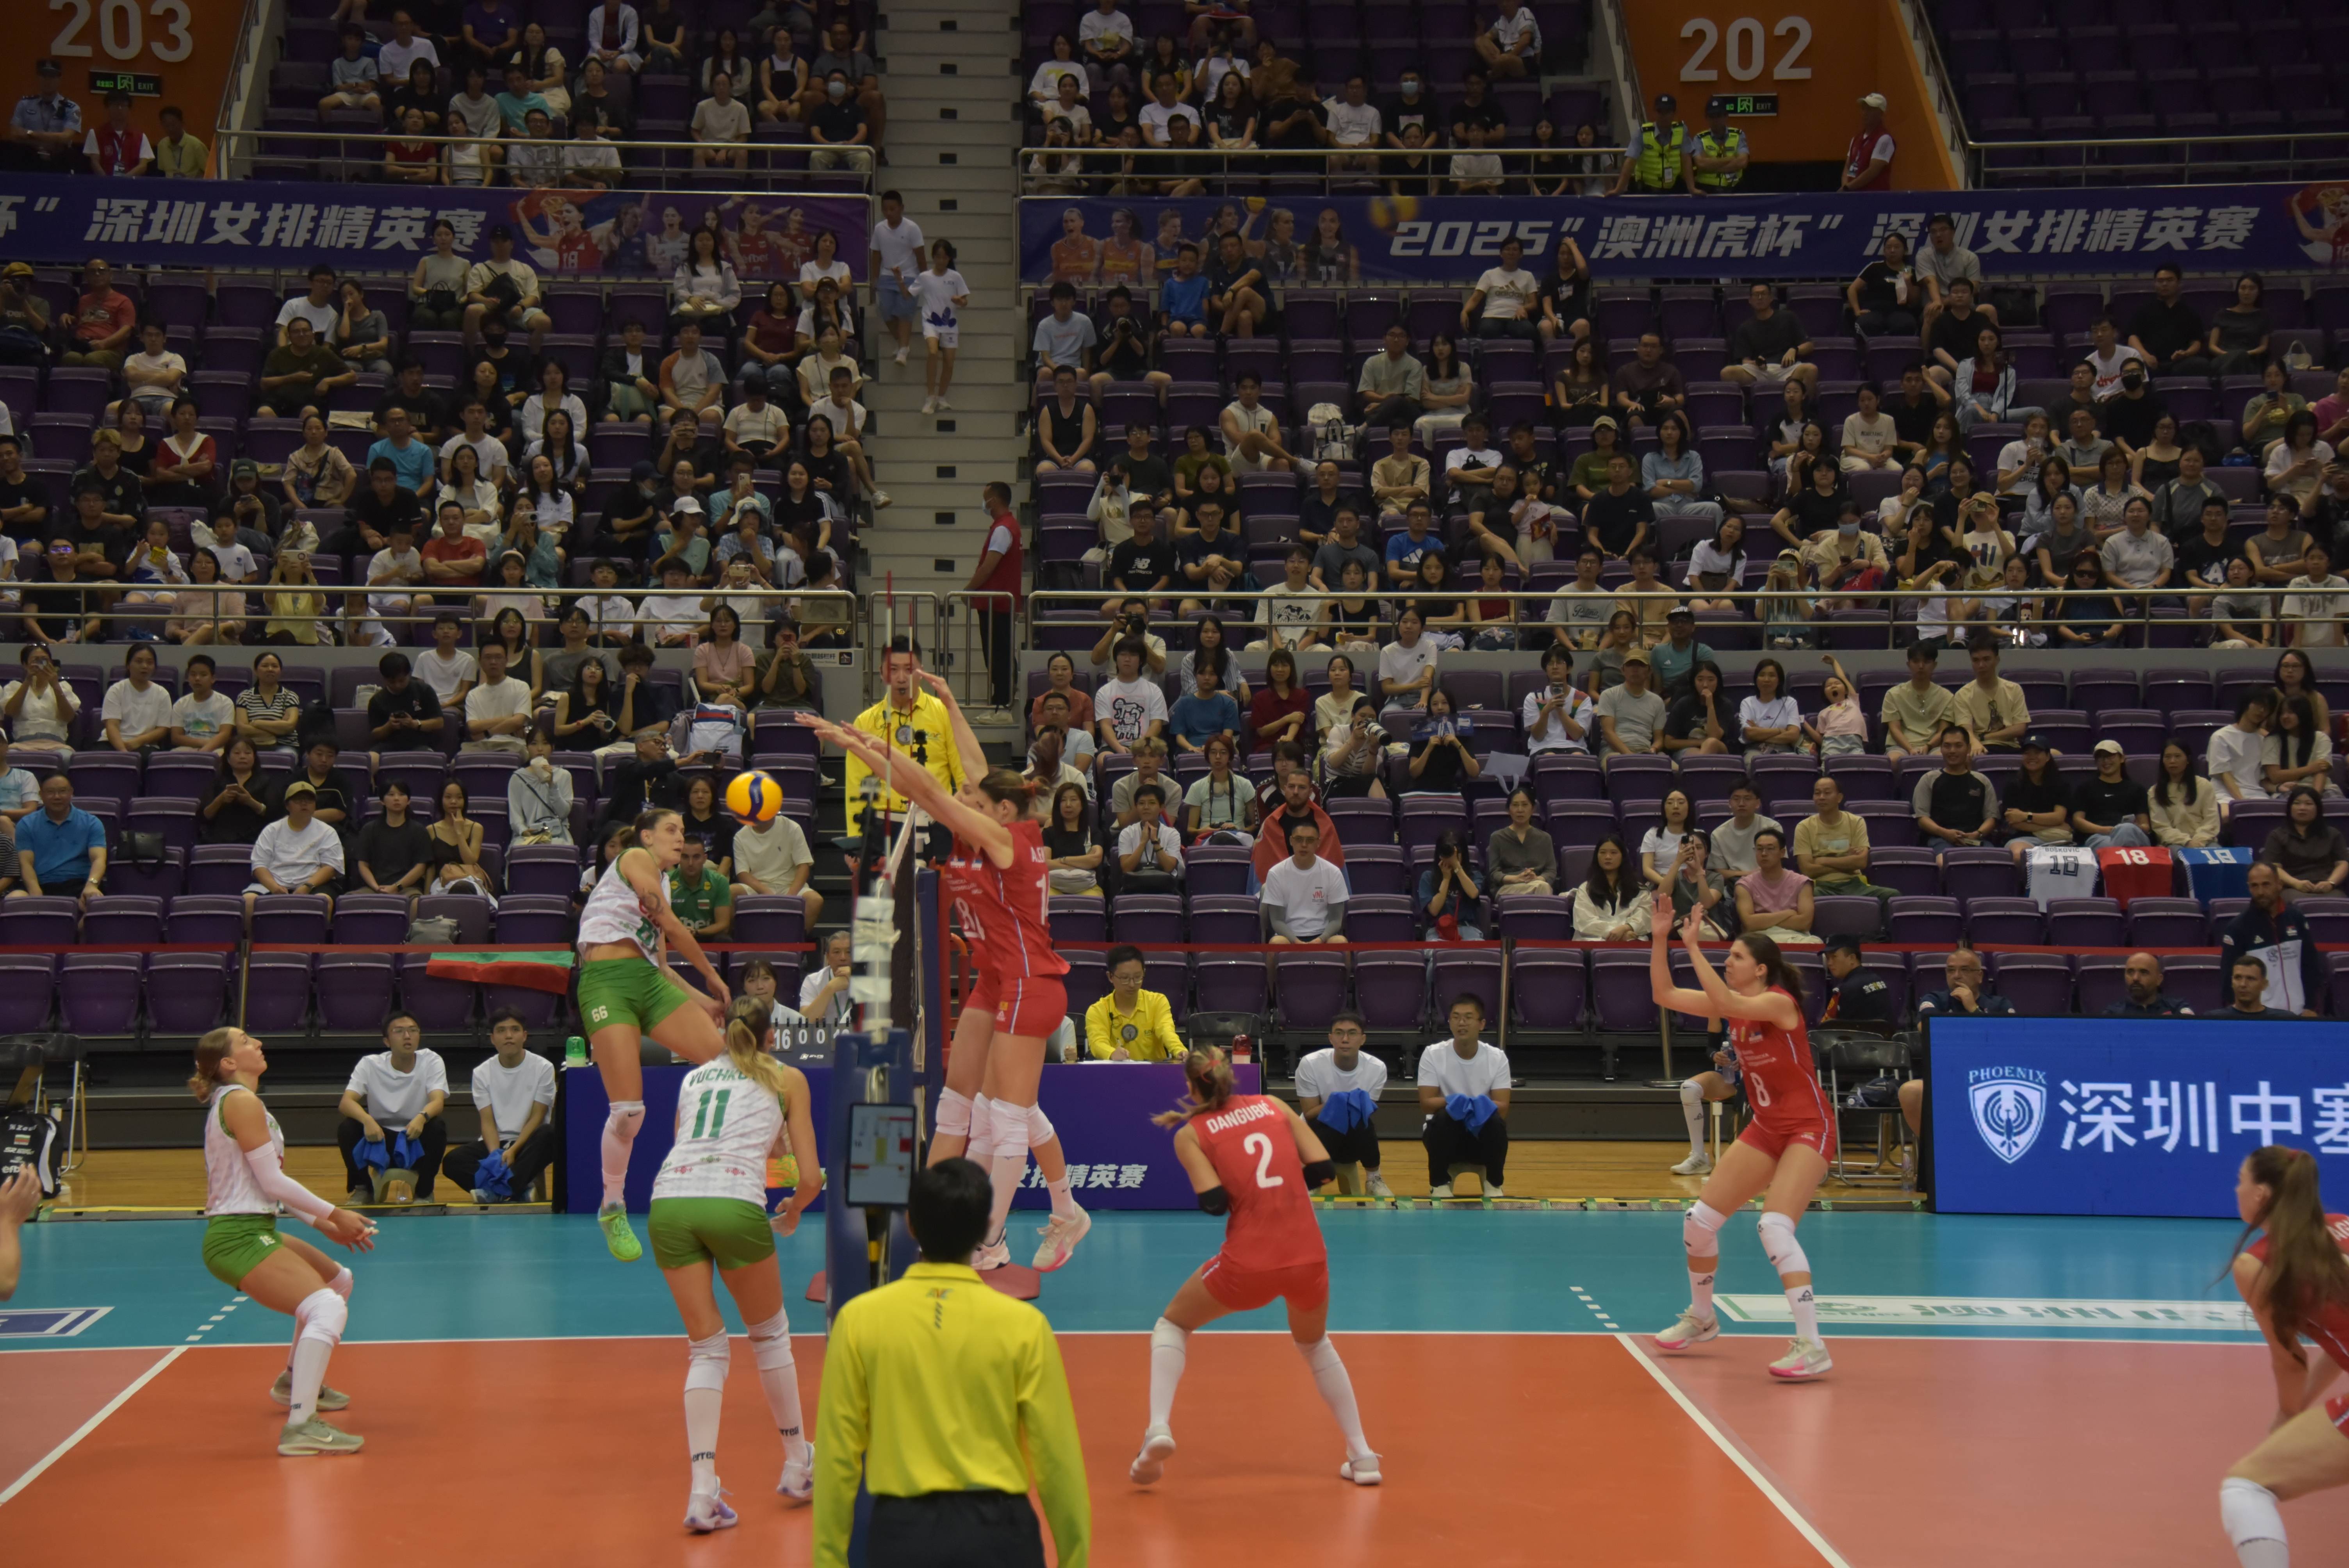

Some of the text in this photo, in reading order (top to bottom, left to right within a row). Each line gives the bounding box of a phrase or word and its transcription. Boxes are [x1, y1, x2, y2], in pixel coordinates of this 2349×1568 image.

[50, 0, 193, 63] 203
[1680, 16, 1812, 82] 202
[138, 82, 153, 91] EXIT
[84, 198, 487, 252] 深圳女排精英赛
[562, 251, 579, 269] 18
[1319, 265, 1337, 281] 11
[2050, 855, 2079, 877] 18
[2115, 850, 2150, 866] 18
[2200, 850, 2238, 864] 18
[591, 1005, 608, 1023] 66
[773, 1029, 791, 1049] 16
[798, 1029, 807, 1044] 0
[816, 1029, 825, 1044] 0
[1968, 1067, 2048, 1085] PHOENIX
[1749, 1071, 1771, 1107] 8
[692, 1089, 732, 1139] 11
[1206, 1101, 1275, 1134] DANGUBIĆ
[1244, 1132, 1284, 1188] 2
